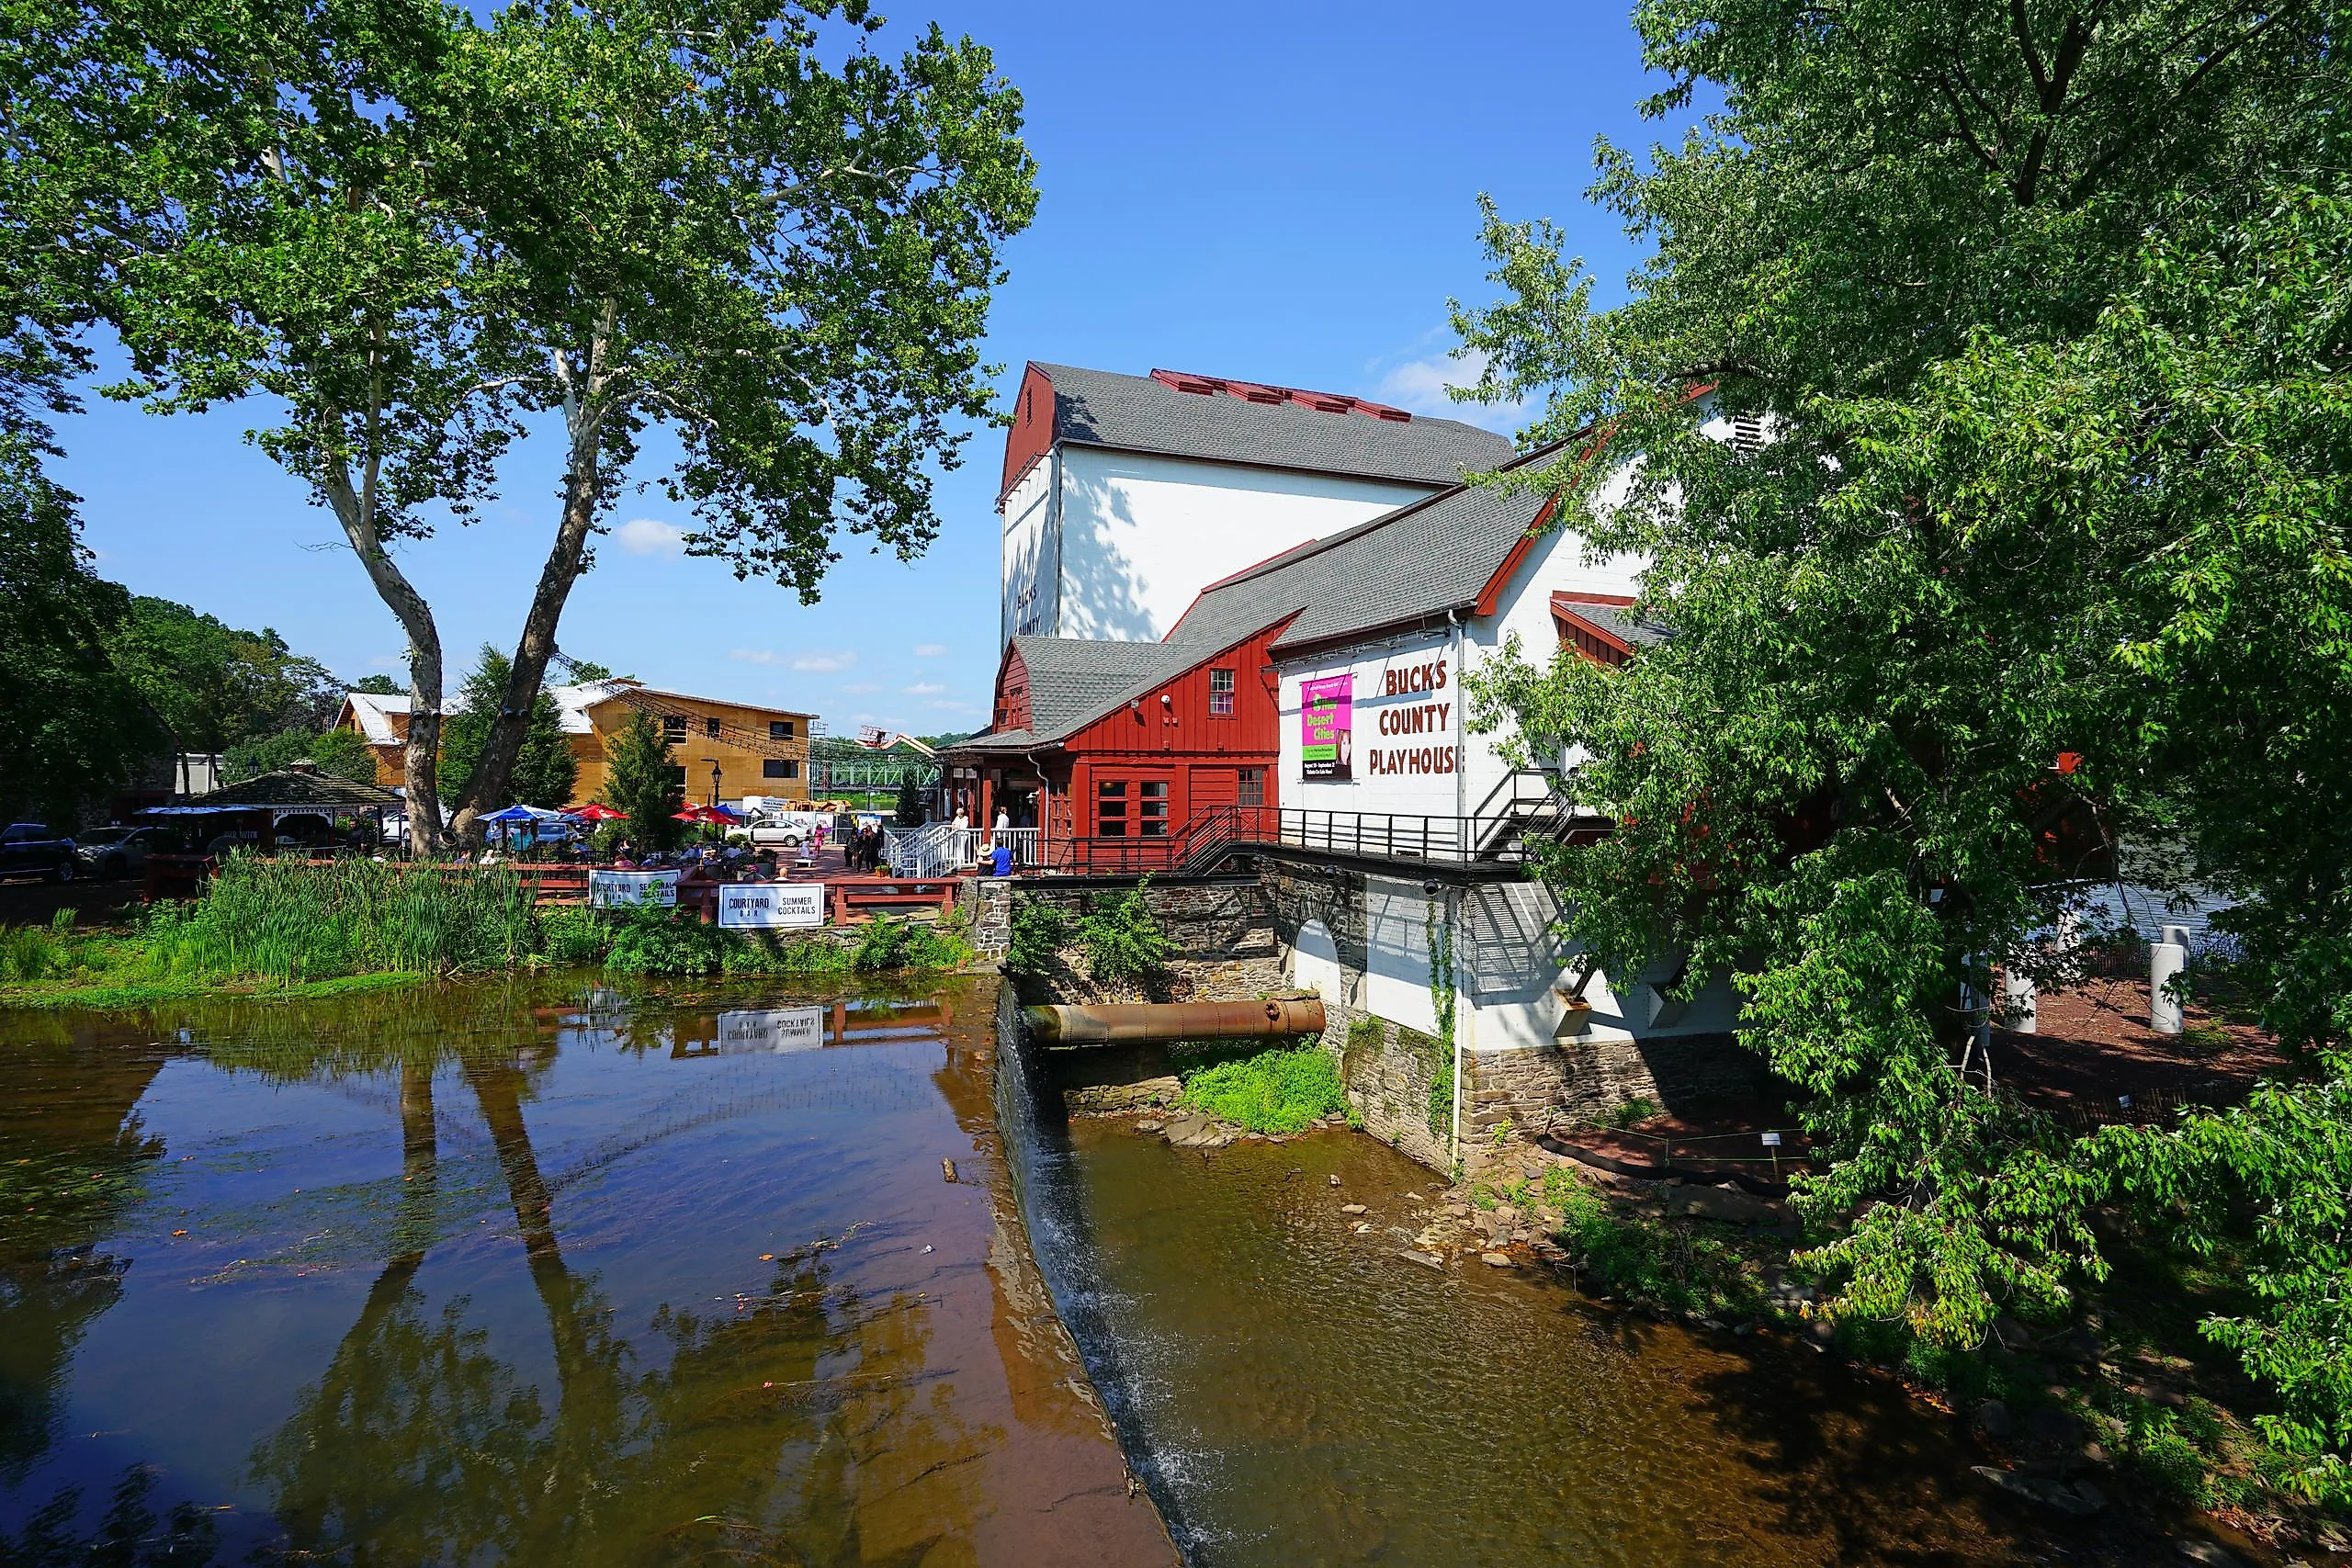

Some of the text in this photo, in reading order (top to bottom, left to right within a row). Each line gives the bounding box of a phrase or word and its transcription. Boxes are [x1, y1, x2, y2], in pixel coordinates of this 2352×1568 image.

[1385, 660, 1447, 696] BUCKS
[1307, 714, 1334, 727] Desert
[1379, 703, 1451, 736] COUNTY
[1314, 727, 1335, 739] Cities
[729, 897, 769, 909] COURTYARD
[782, 897, 812, 906] SUMMER
[777, 906, 816, 915] COCKTAILS
